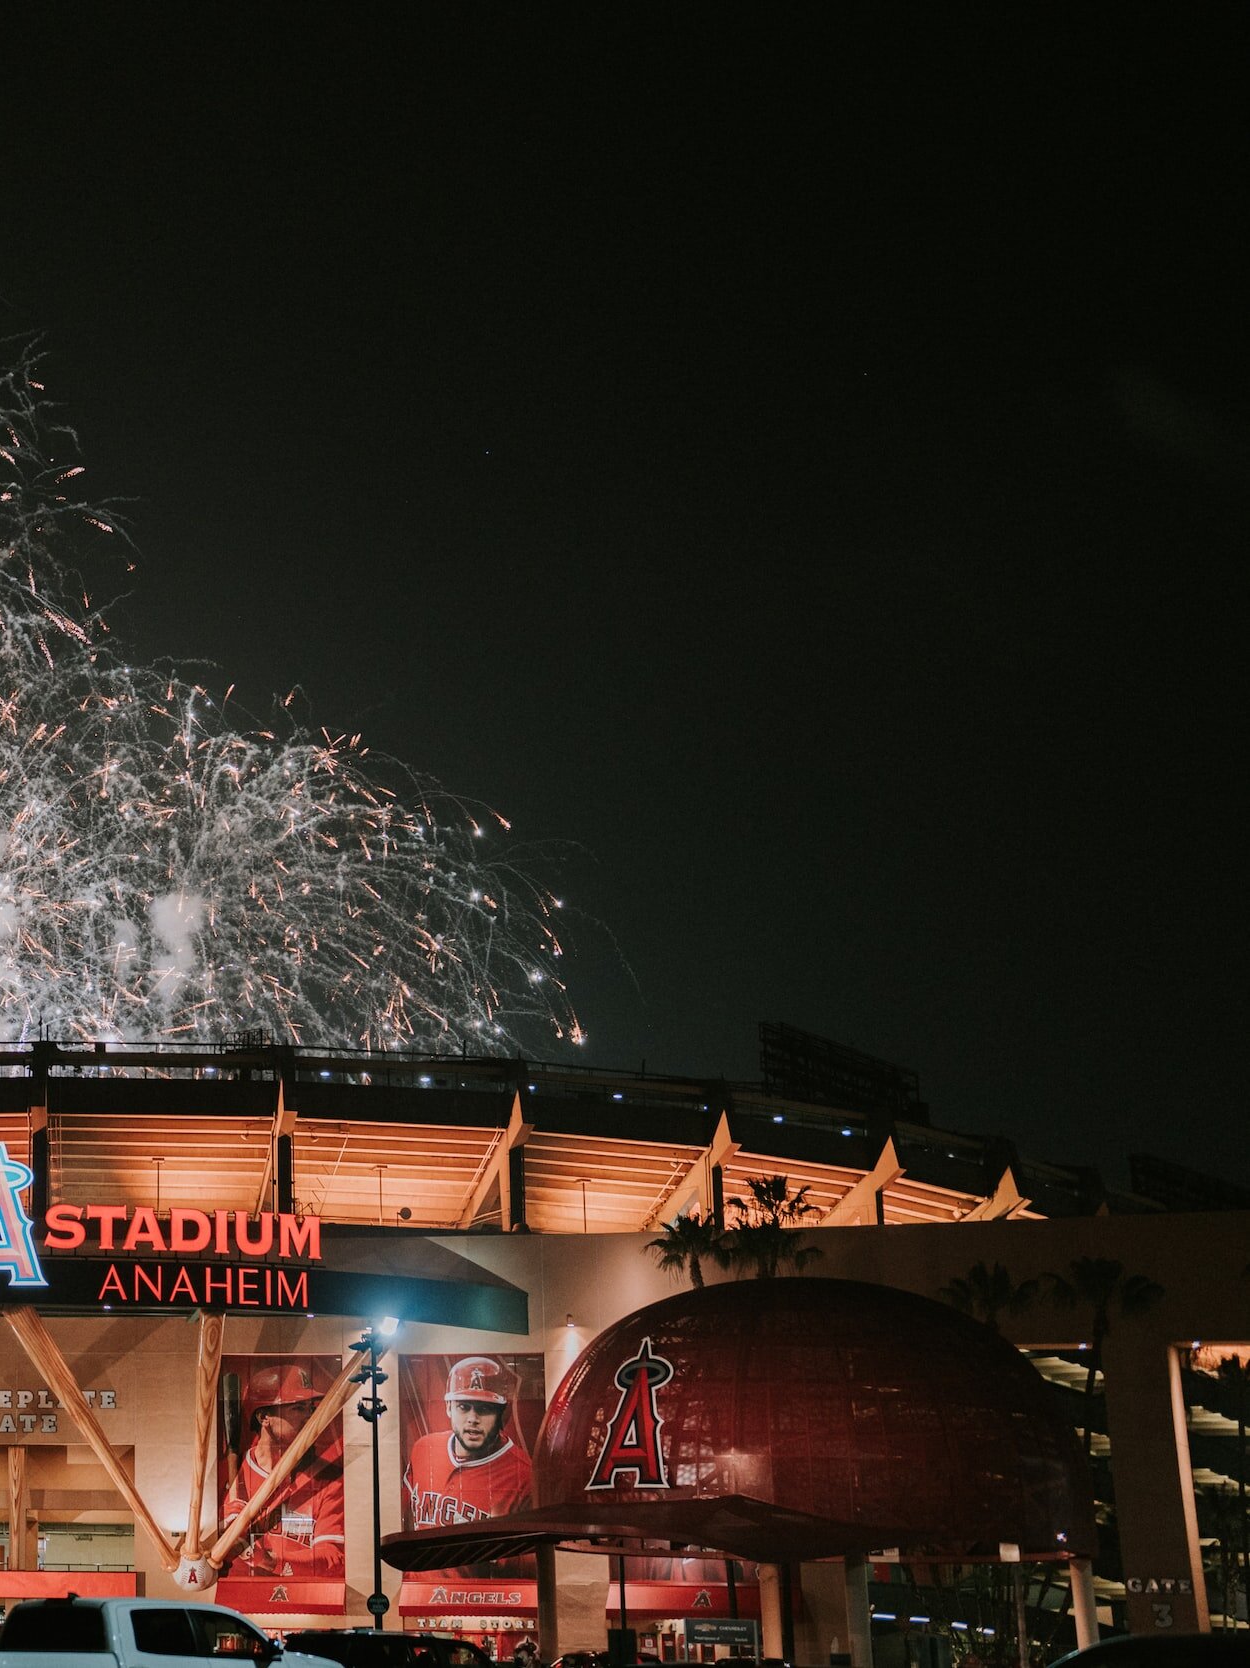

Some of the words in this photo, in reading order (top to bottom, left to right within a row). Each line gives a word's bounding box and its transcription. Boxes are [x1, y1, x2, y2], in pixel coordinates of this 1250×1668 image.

[44, 1204, 323, 1260] STADIUM
[98, 1264, 309, 1308] ANAHEIM
[584, 1336, 674, 1490] A
[429, 1585, 522, 1605] ANGELS
[1127, 1578, 1192, 1594] GATE
[417, 1618, 463, 1628] TEAM
[480, 1618, 535, 1629] STORE
[1152, 1604, 1173, 1628] 3
